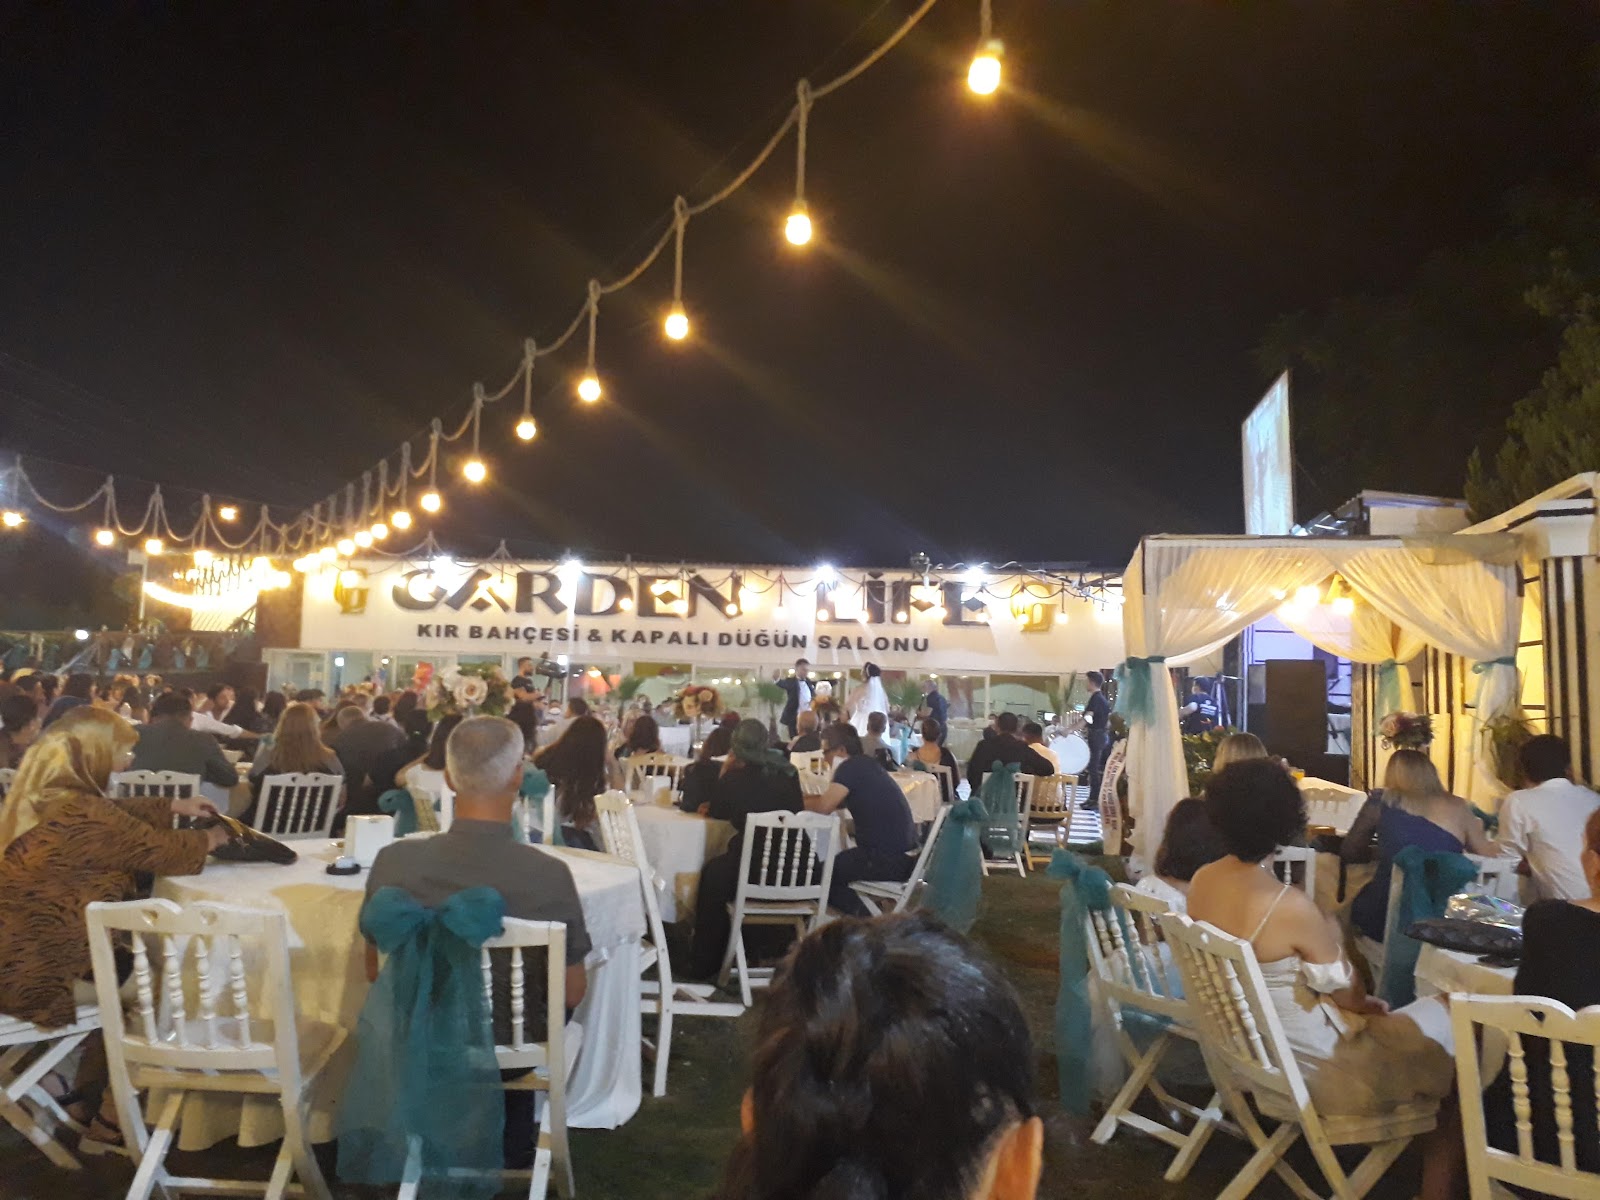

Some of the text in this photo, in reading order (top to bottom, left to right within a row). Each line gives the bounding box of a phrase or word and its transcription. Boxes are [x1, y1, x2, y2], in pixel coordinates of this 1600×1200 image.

[392, 568, 743, 620] GARDEN
[417, 624, 930, 652] KIR BAHÇESİ & KAPALI DÜĞÜN SALONU
